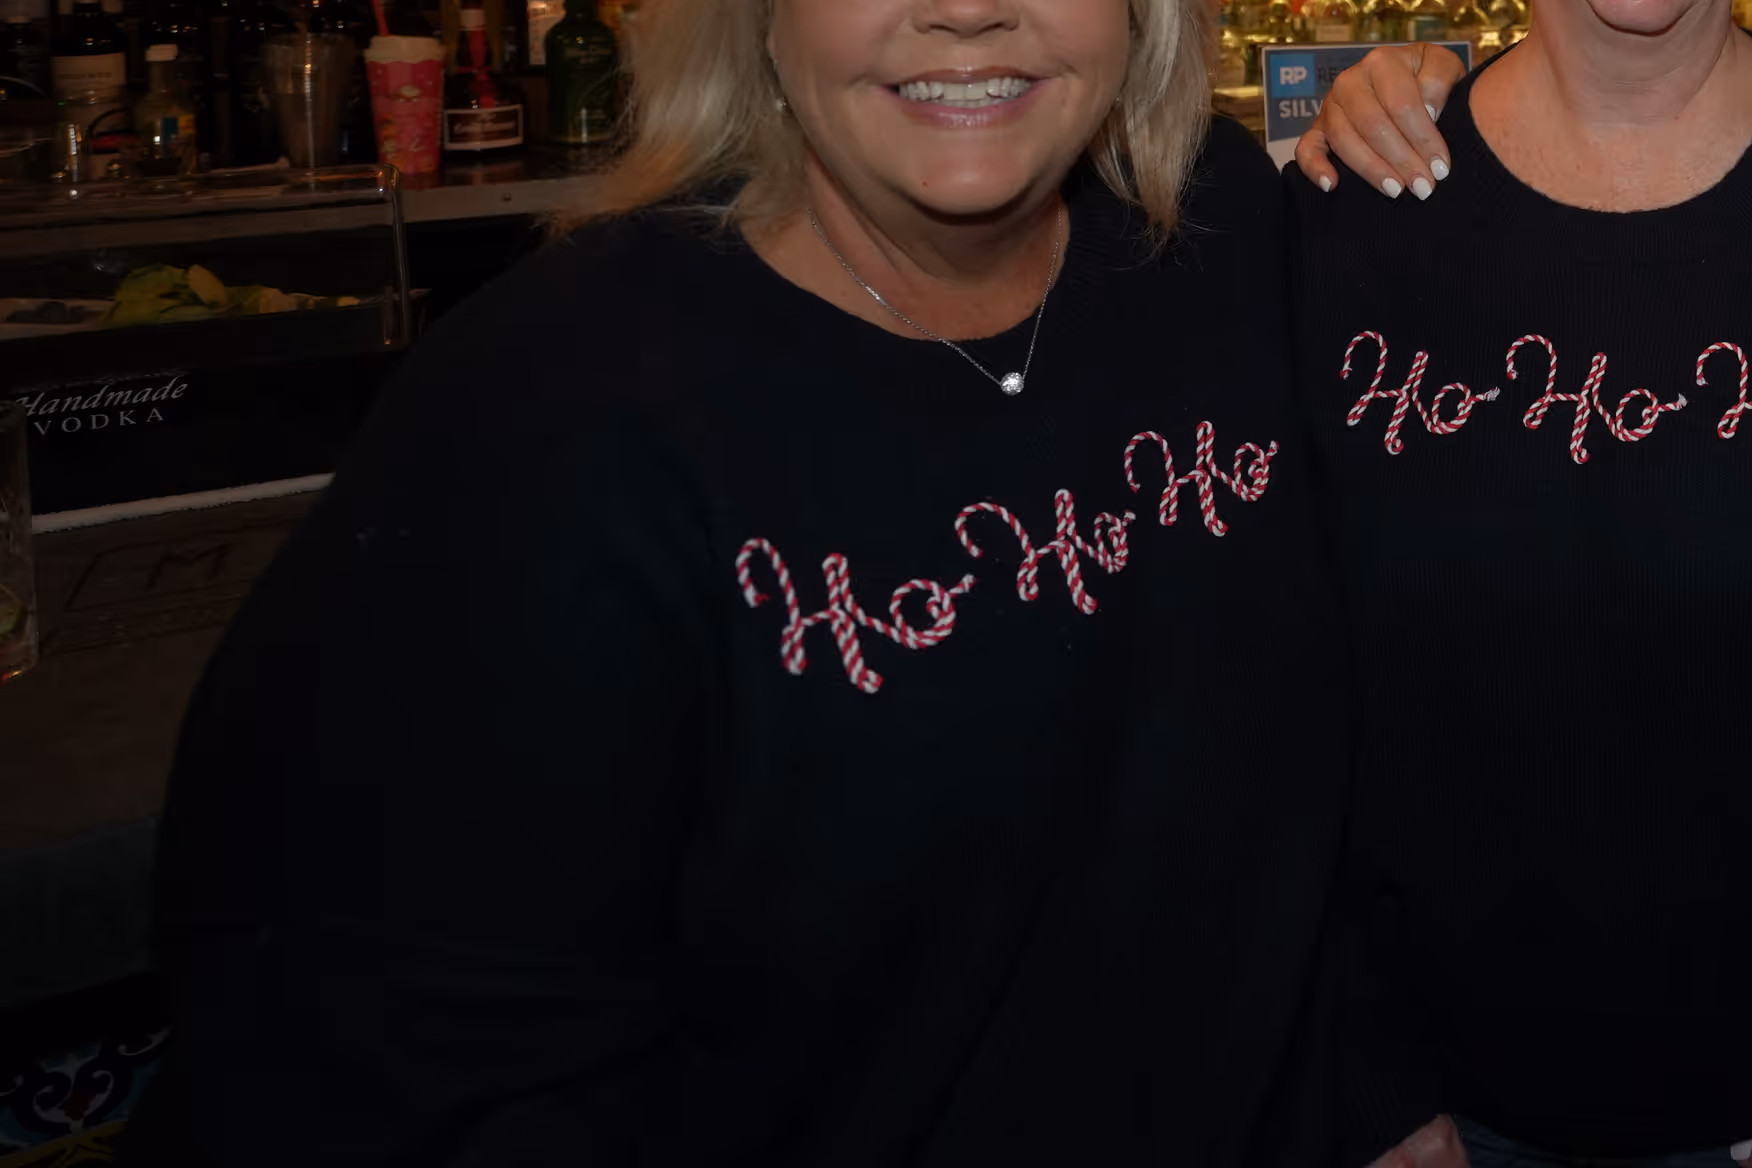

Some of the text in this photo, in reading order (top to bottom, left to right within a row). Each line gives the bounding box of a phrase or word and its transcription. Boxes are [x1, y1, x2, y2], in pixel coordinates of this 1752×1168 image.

[1280, 66, 1308, 85] RP
[15, 376, 189, 418] Handmade
[1340, 330, 1501, 456] Ho
[1505, 334, 1688, 464] Ho
[33, 407, 165, 437] VODKA
[735, 420, 1281, 695] Ho Ho Ho
